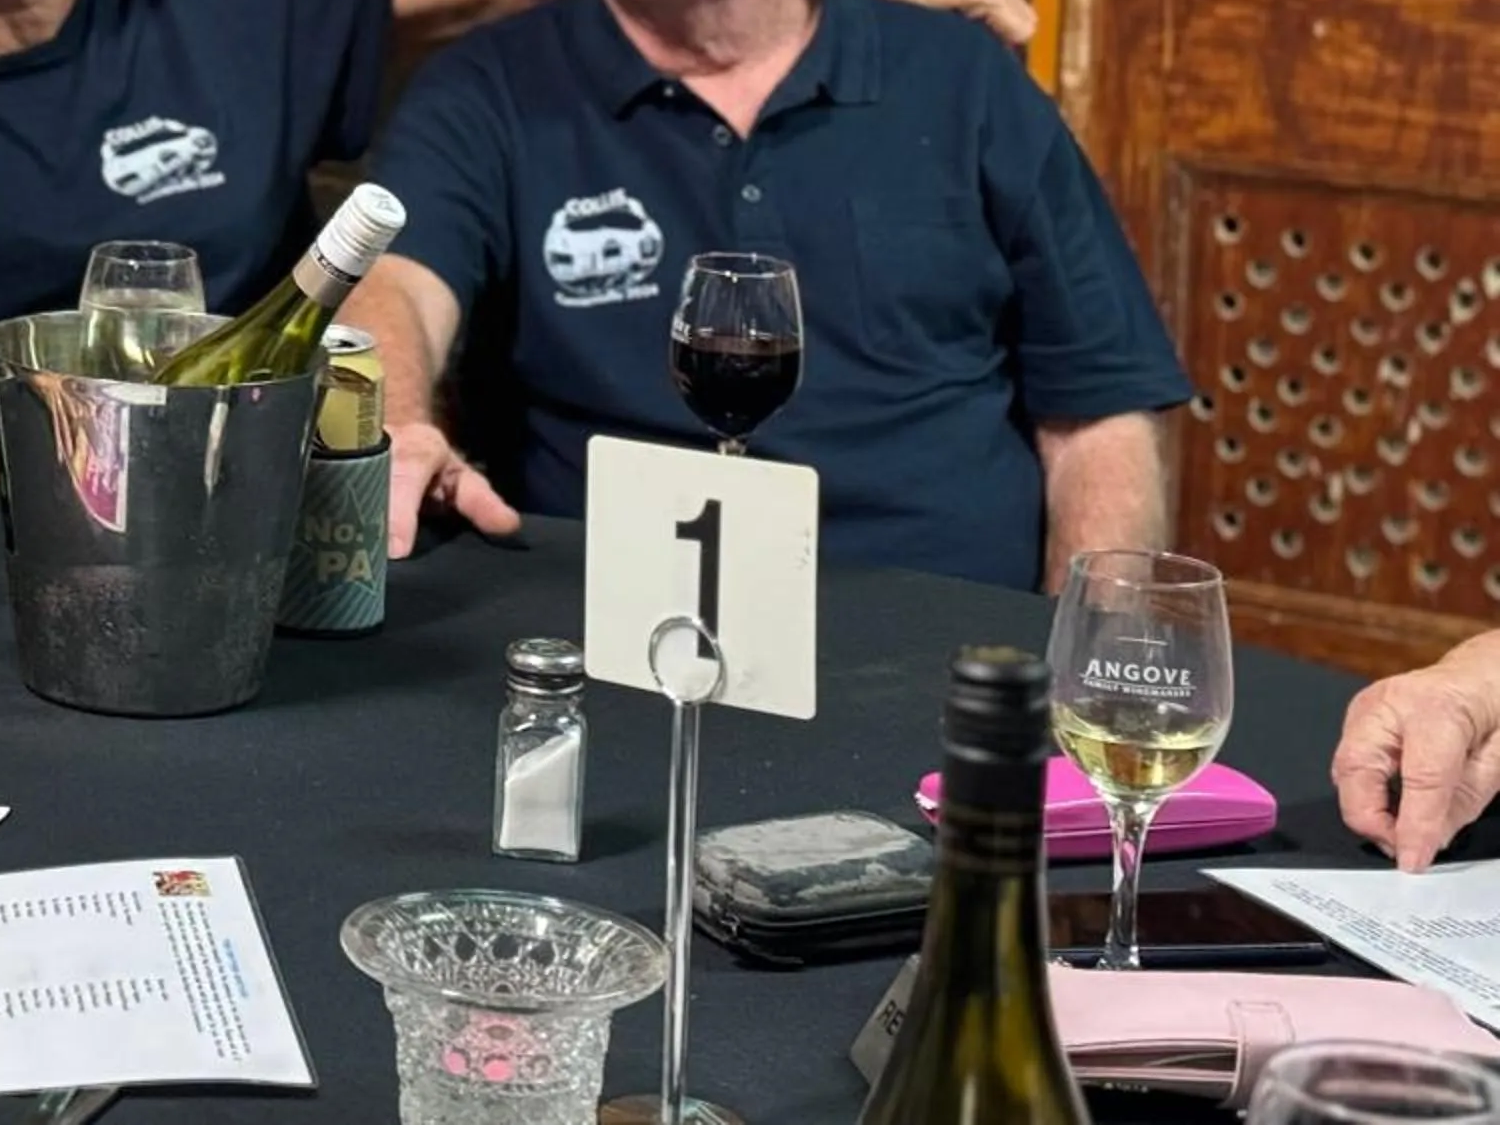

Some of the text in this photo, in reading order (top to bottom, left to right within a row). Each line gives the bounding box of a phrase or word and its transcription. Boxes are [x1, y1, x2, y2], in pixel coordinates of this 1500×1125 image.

[675, 498, 722, 659] 1
[1083, 658, 1191, 686] ANGOVE
[876, 999, 906, 1037] RE
